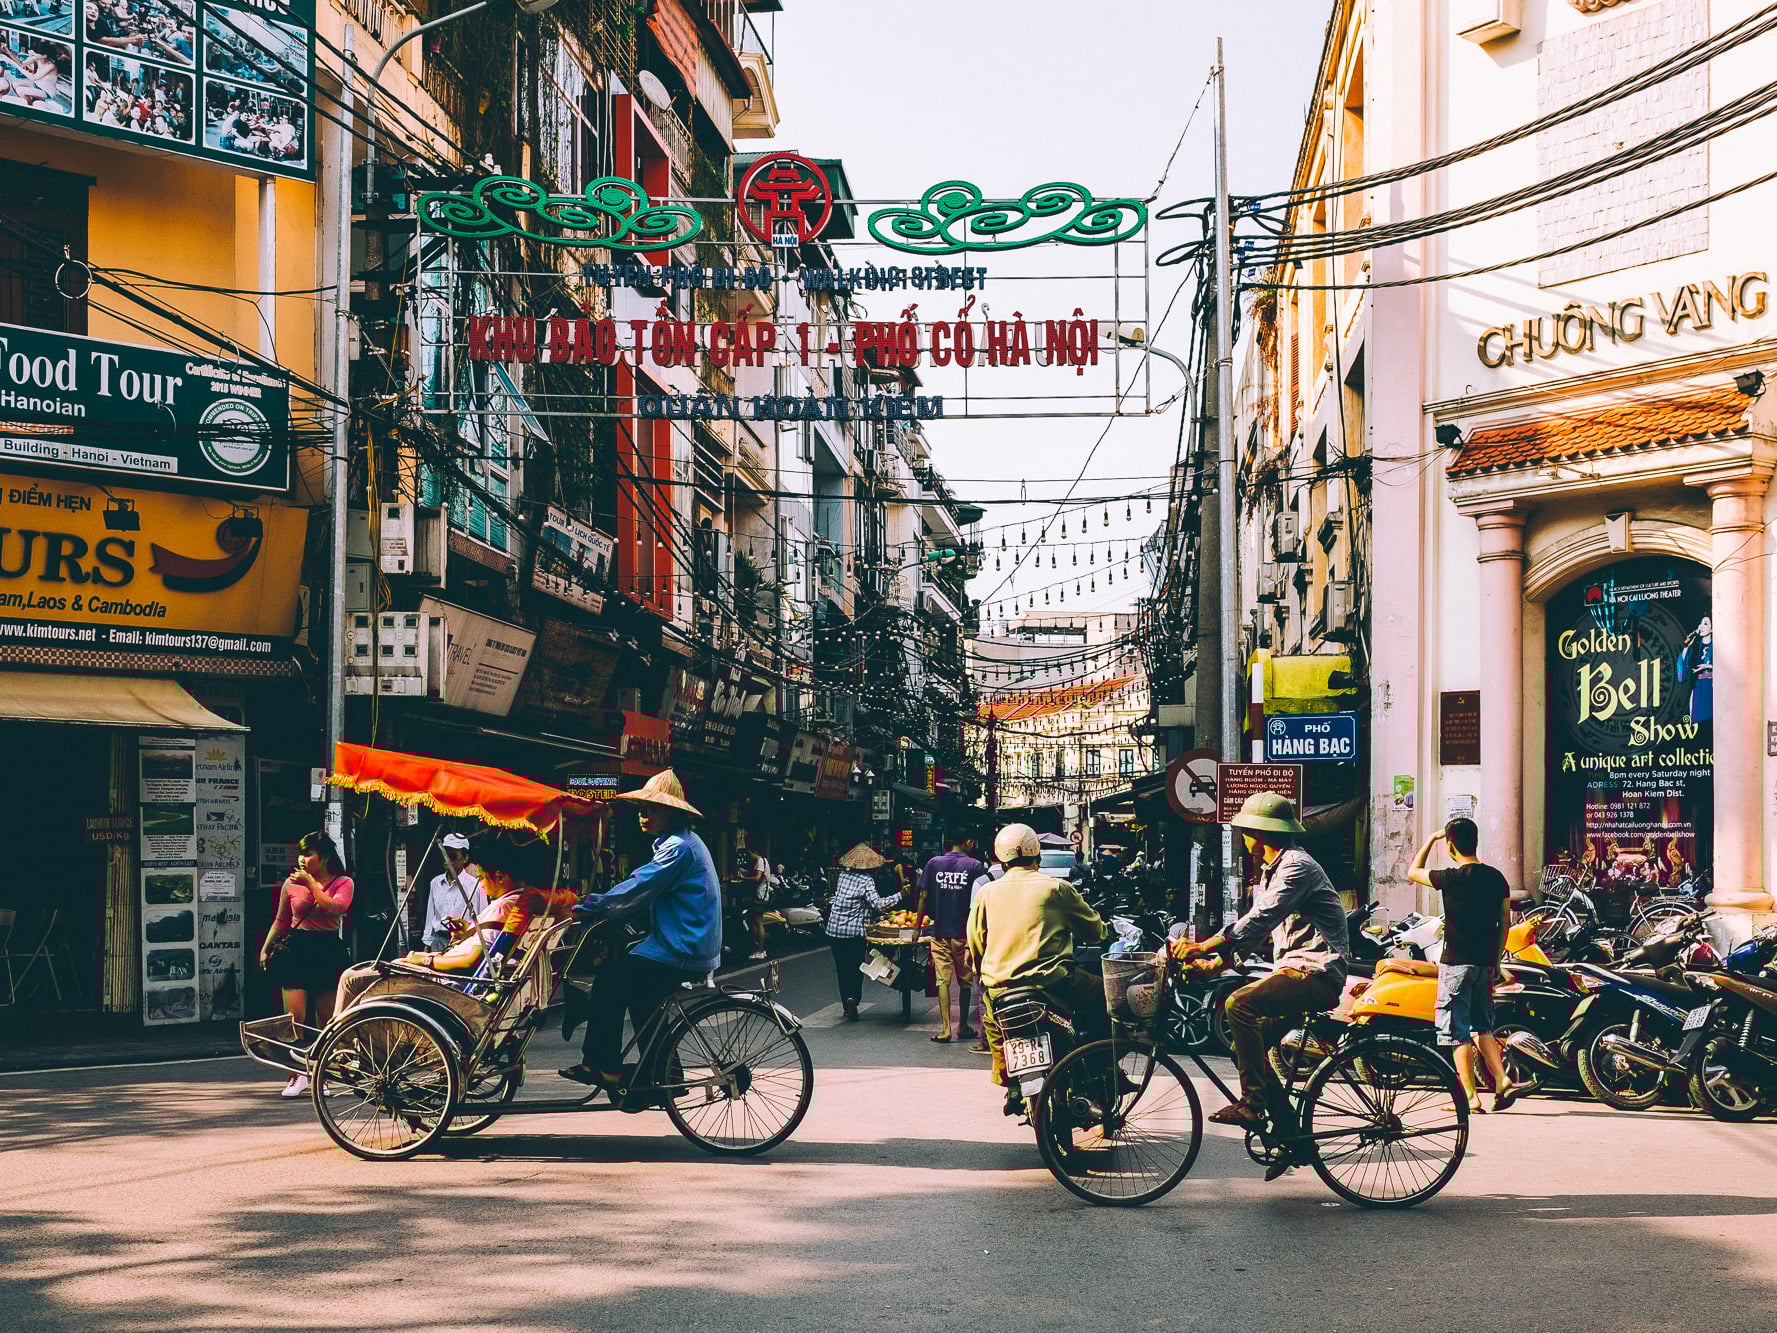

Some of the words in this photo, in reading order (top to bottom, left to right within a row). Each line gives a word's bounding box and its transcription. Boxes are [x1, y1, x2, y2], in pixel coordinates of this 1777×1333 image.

[800, 266, 899, 291] WALKING
[911, 266, 988, 291] STREET
[1477, 297, 1645, 369] CHUÔNG
[1649, 271, 1770, 336] VÀNG
[468, 314, 536, 363] KHU
[709, 302, 776, 367] CẤP
[797, 322, 810, 366] 1
[855, 303, 918, 367] PHỐ
[931, 293, 976, 367] CỔ
[987, 310, 1031, 366] HÀ
[1045, 307, 1099, 376] NỘI
[90, 351, 183, 405] Tour
[1, 389, 86, 417] Hanoian
[4, 440, 59, 458] Building
[72, 447, 109, 463] Hanoi
[120, 453, 171, 470] Vietnam
[9, 483, 52, 508] ĐIỂM
[56, 493, 91, 513] HẸN
[1659, 589, 1682, 598] THEATER
[71, 594, 83, 612] &
[88, 595, 167, 618] Cambodia
[109, 629, 143, 646] Email:
[145, 632, 272, 653] kimtours137@gmail.com
[1558, 628, 1631, 660] Golden
[1577, 657, 1661, 724] Bell
[1304, 720, 1331, 733] PHỐ
[1628, 714, 1700, 746] Show
[1271, 735, 1315, 756] HÀNG
[1321, 737, 1351, 758] BẠC
[1562, 752, 1576, 773] A
[1580, 752, 1626, 772] unique
[1631, 750, 1654, 767] art
[1609, 771, 1627, 780] 8pm
[1628, 771, 1650, 780] every
[1651, 769, 1688, 779] Saturday
[1689, 767, 1711, 778] night
[1622, 790, 1643, 799] Hoan
[1644, 789, 1665, 798] Kiem
[1666, 788, 1685, 798] Dist.
[1636, 779, 1657, 789] Hang
[1658, 778, 1674, 788] Bac
[935, 870, 969, 885] CAFÉ
[199, 941, 241, 949] QANTAS
[1013, 1051, 1045, 1069] 7368
